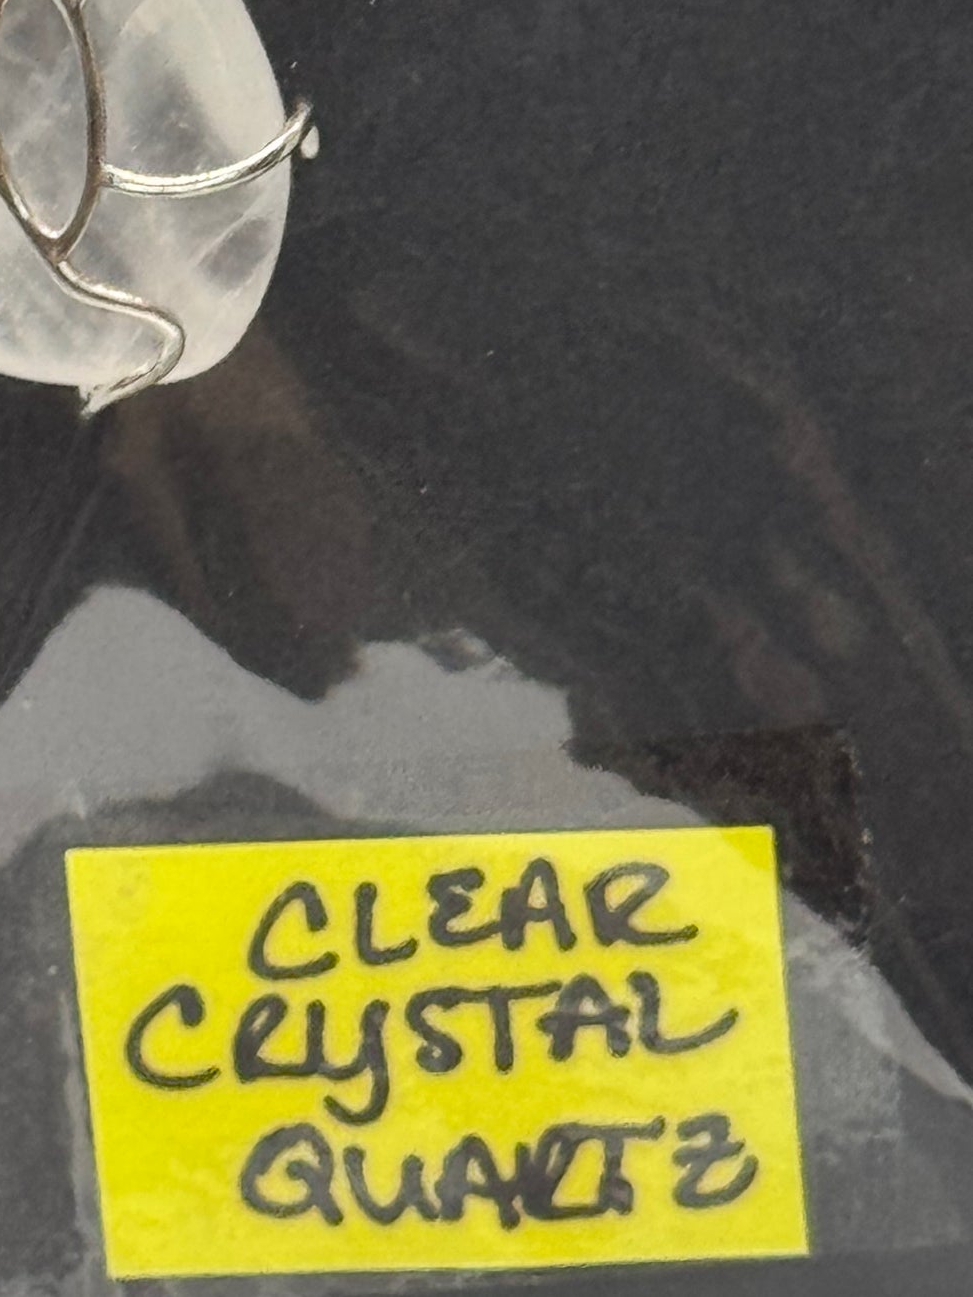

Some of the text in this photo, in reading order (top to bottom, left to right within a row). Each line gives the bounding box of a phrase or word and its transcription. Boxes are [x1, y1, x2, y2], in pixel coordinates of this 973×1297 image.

[247, 857, 699, 982] CLEAR
[124, 970, 739, 1127] CRYSTAL
[239, 1114, 759, 1231] QUARTZ
